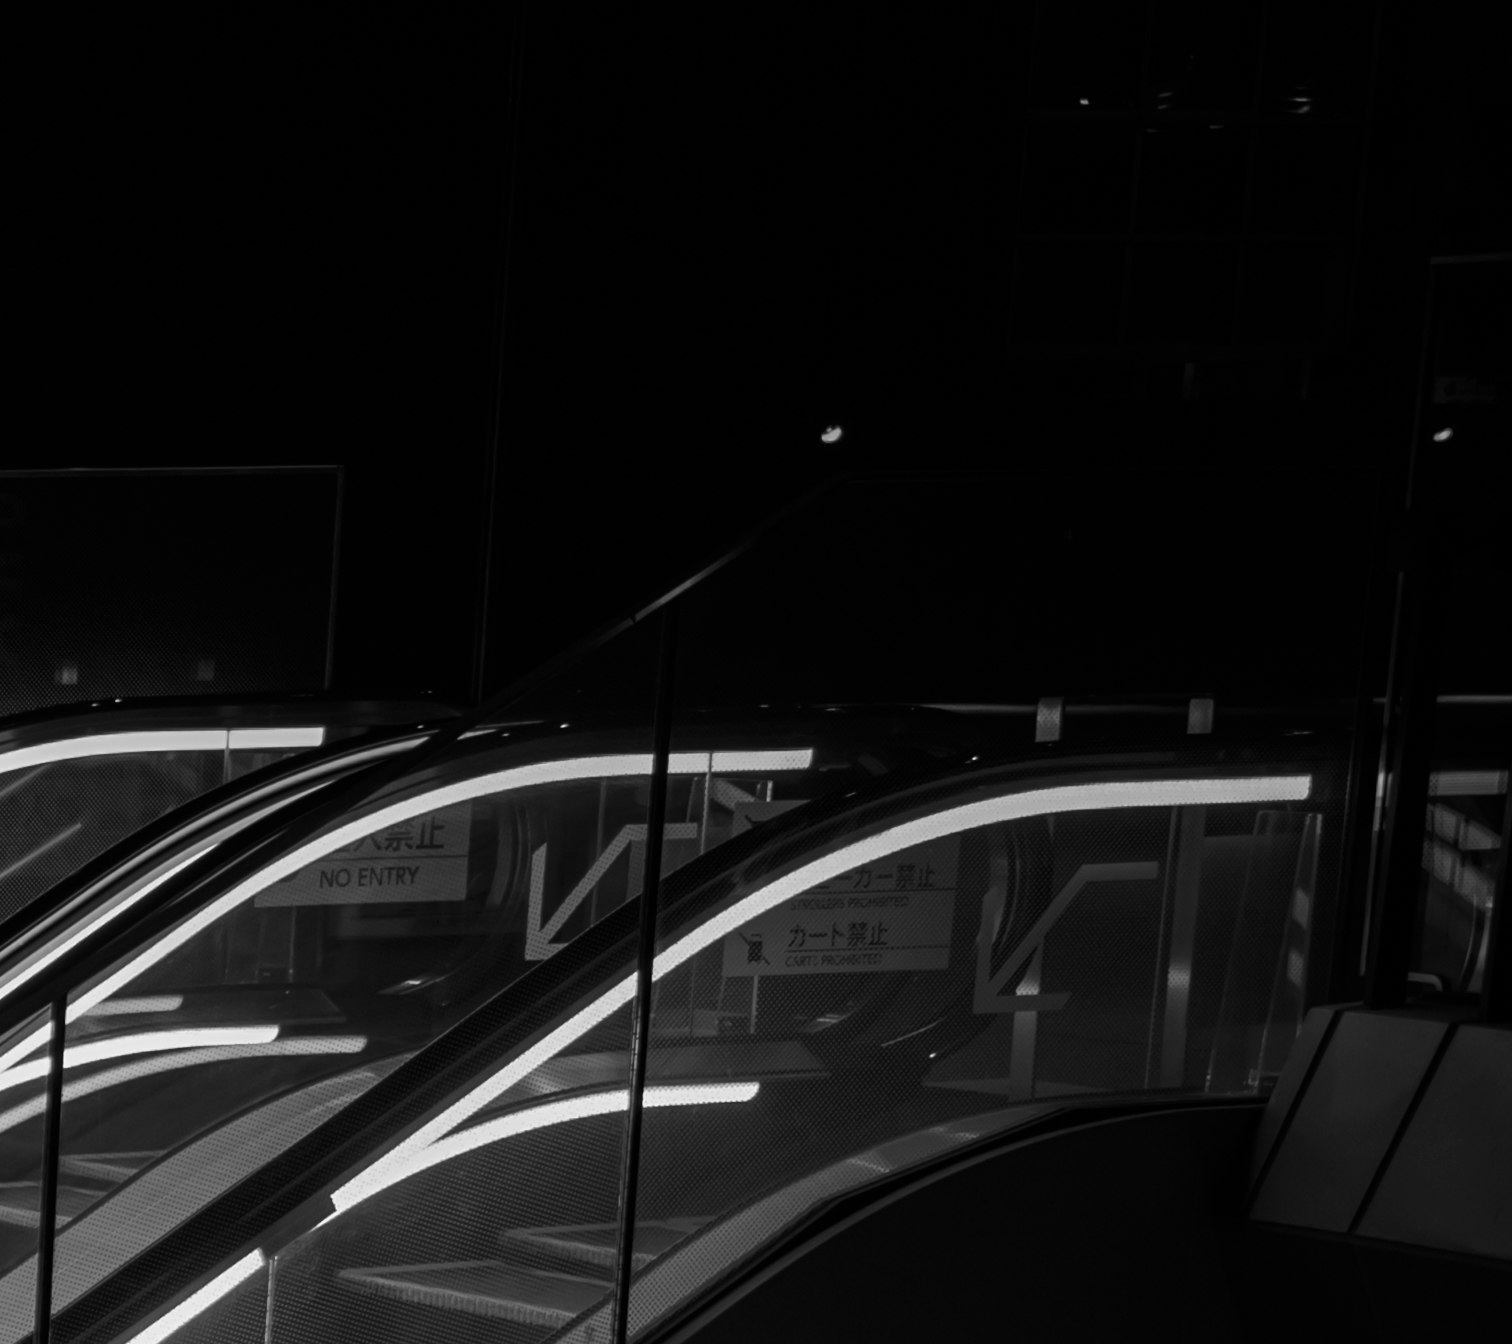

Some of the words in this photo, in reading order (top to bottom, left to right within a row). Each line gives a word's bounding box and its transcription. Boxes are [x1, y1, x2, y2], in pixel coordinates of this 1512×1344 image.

[333, 816, 445, 852] 入禁止
[319, 868, 352, 888] NO
[357, 865, 421, 886] ENTRY
[787, 921, 889, 947] カート禁止
